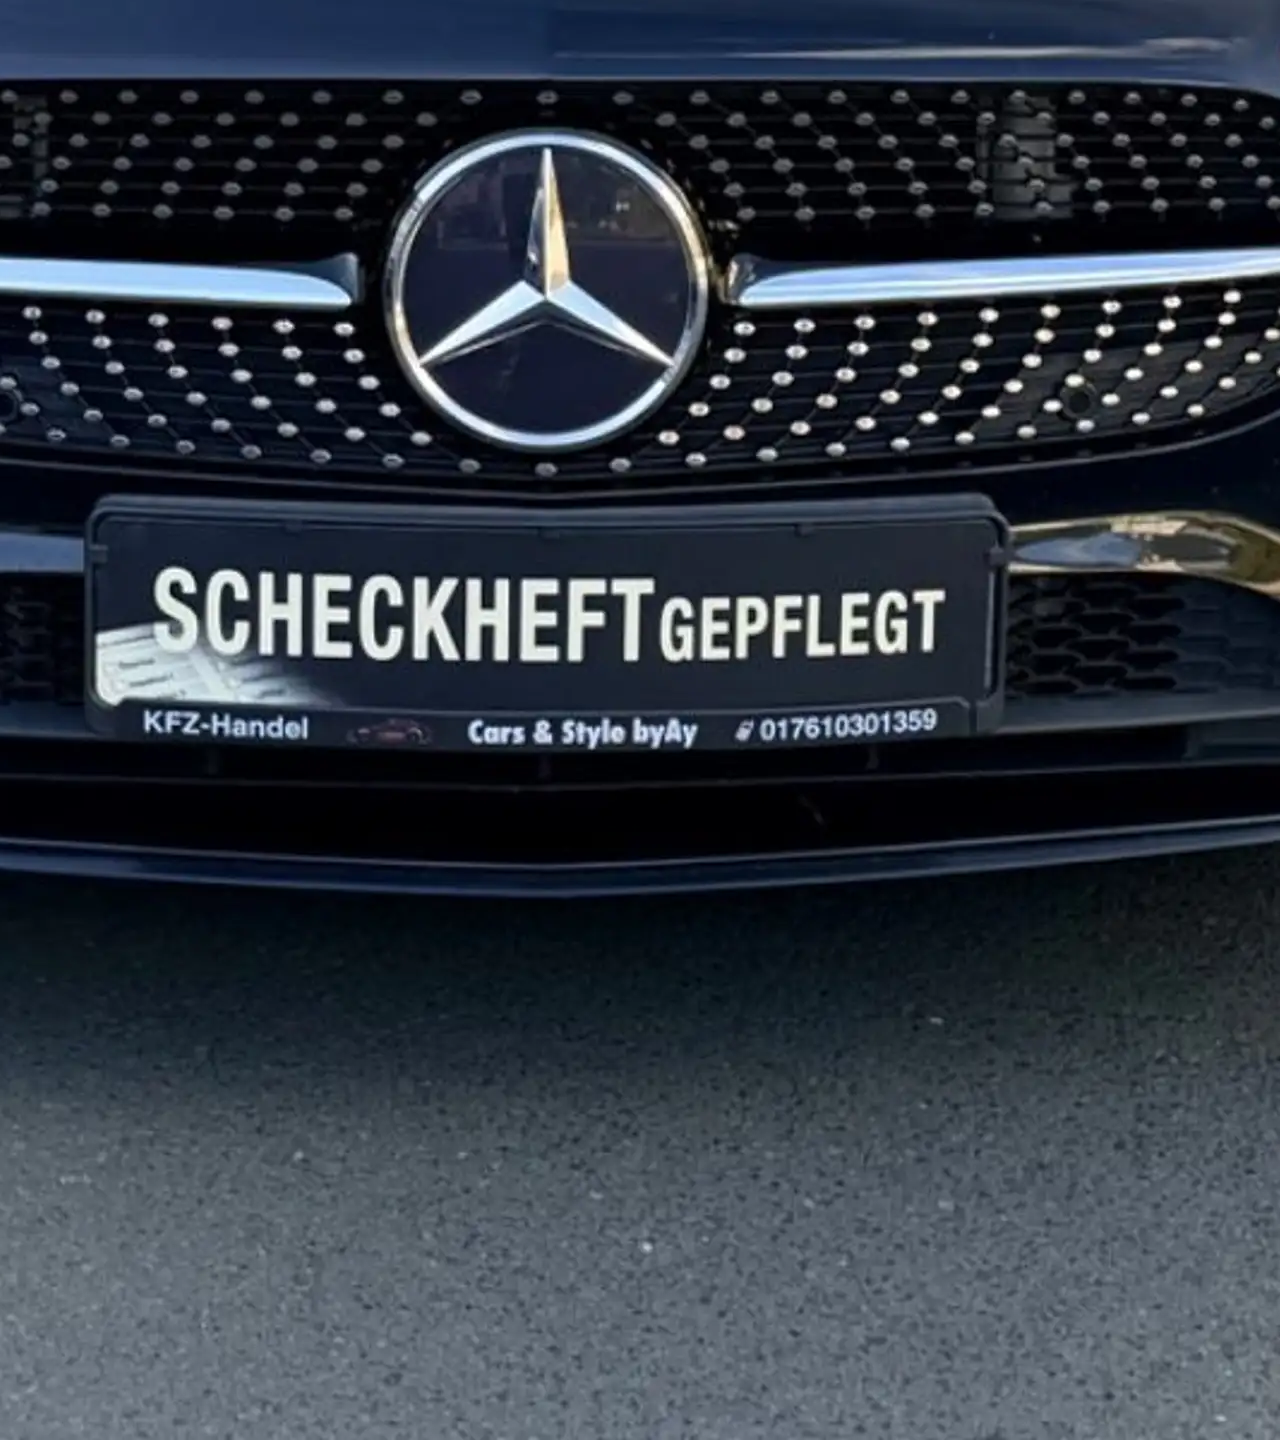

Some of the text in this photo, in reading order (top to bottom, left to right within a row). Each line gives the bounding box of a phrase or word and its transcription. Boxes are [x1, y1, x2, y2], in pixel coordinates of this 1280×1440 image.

[152, 565, 946, 662] SCHECKHEFT GEPFLEGT
[143, 707, 938, 750] KFZ-Handel Cars & Style byAy 017610301359
